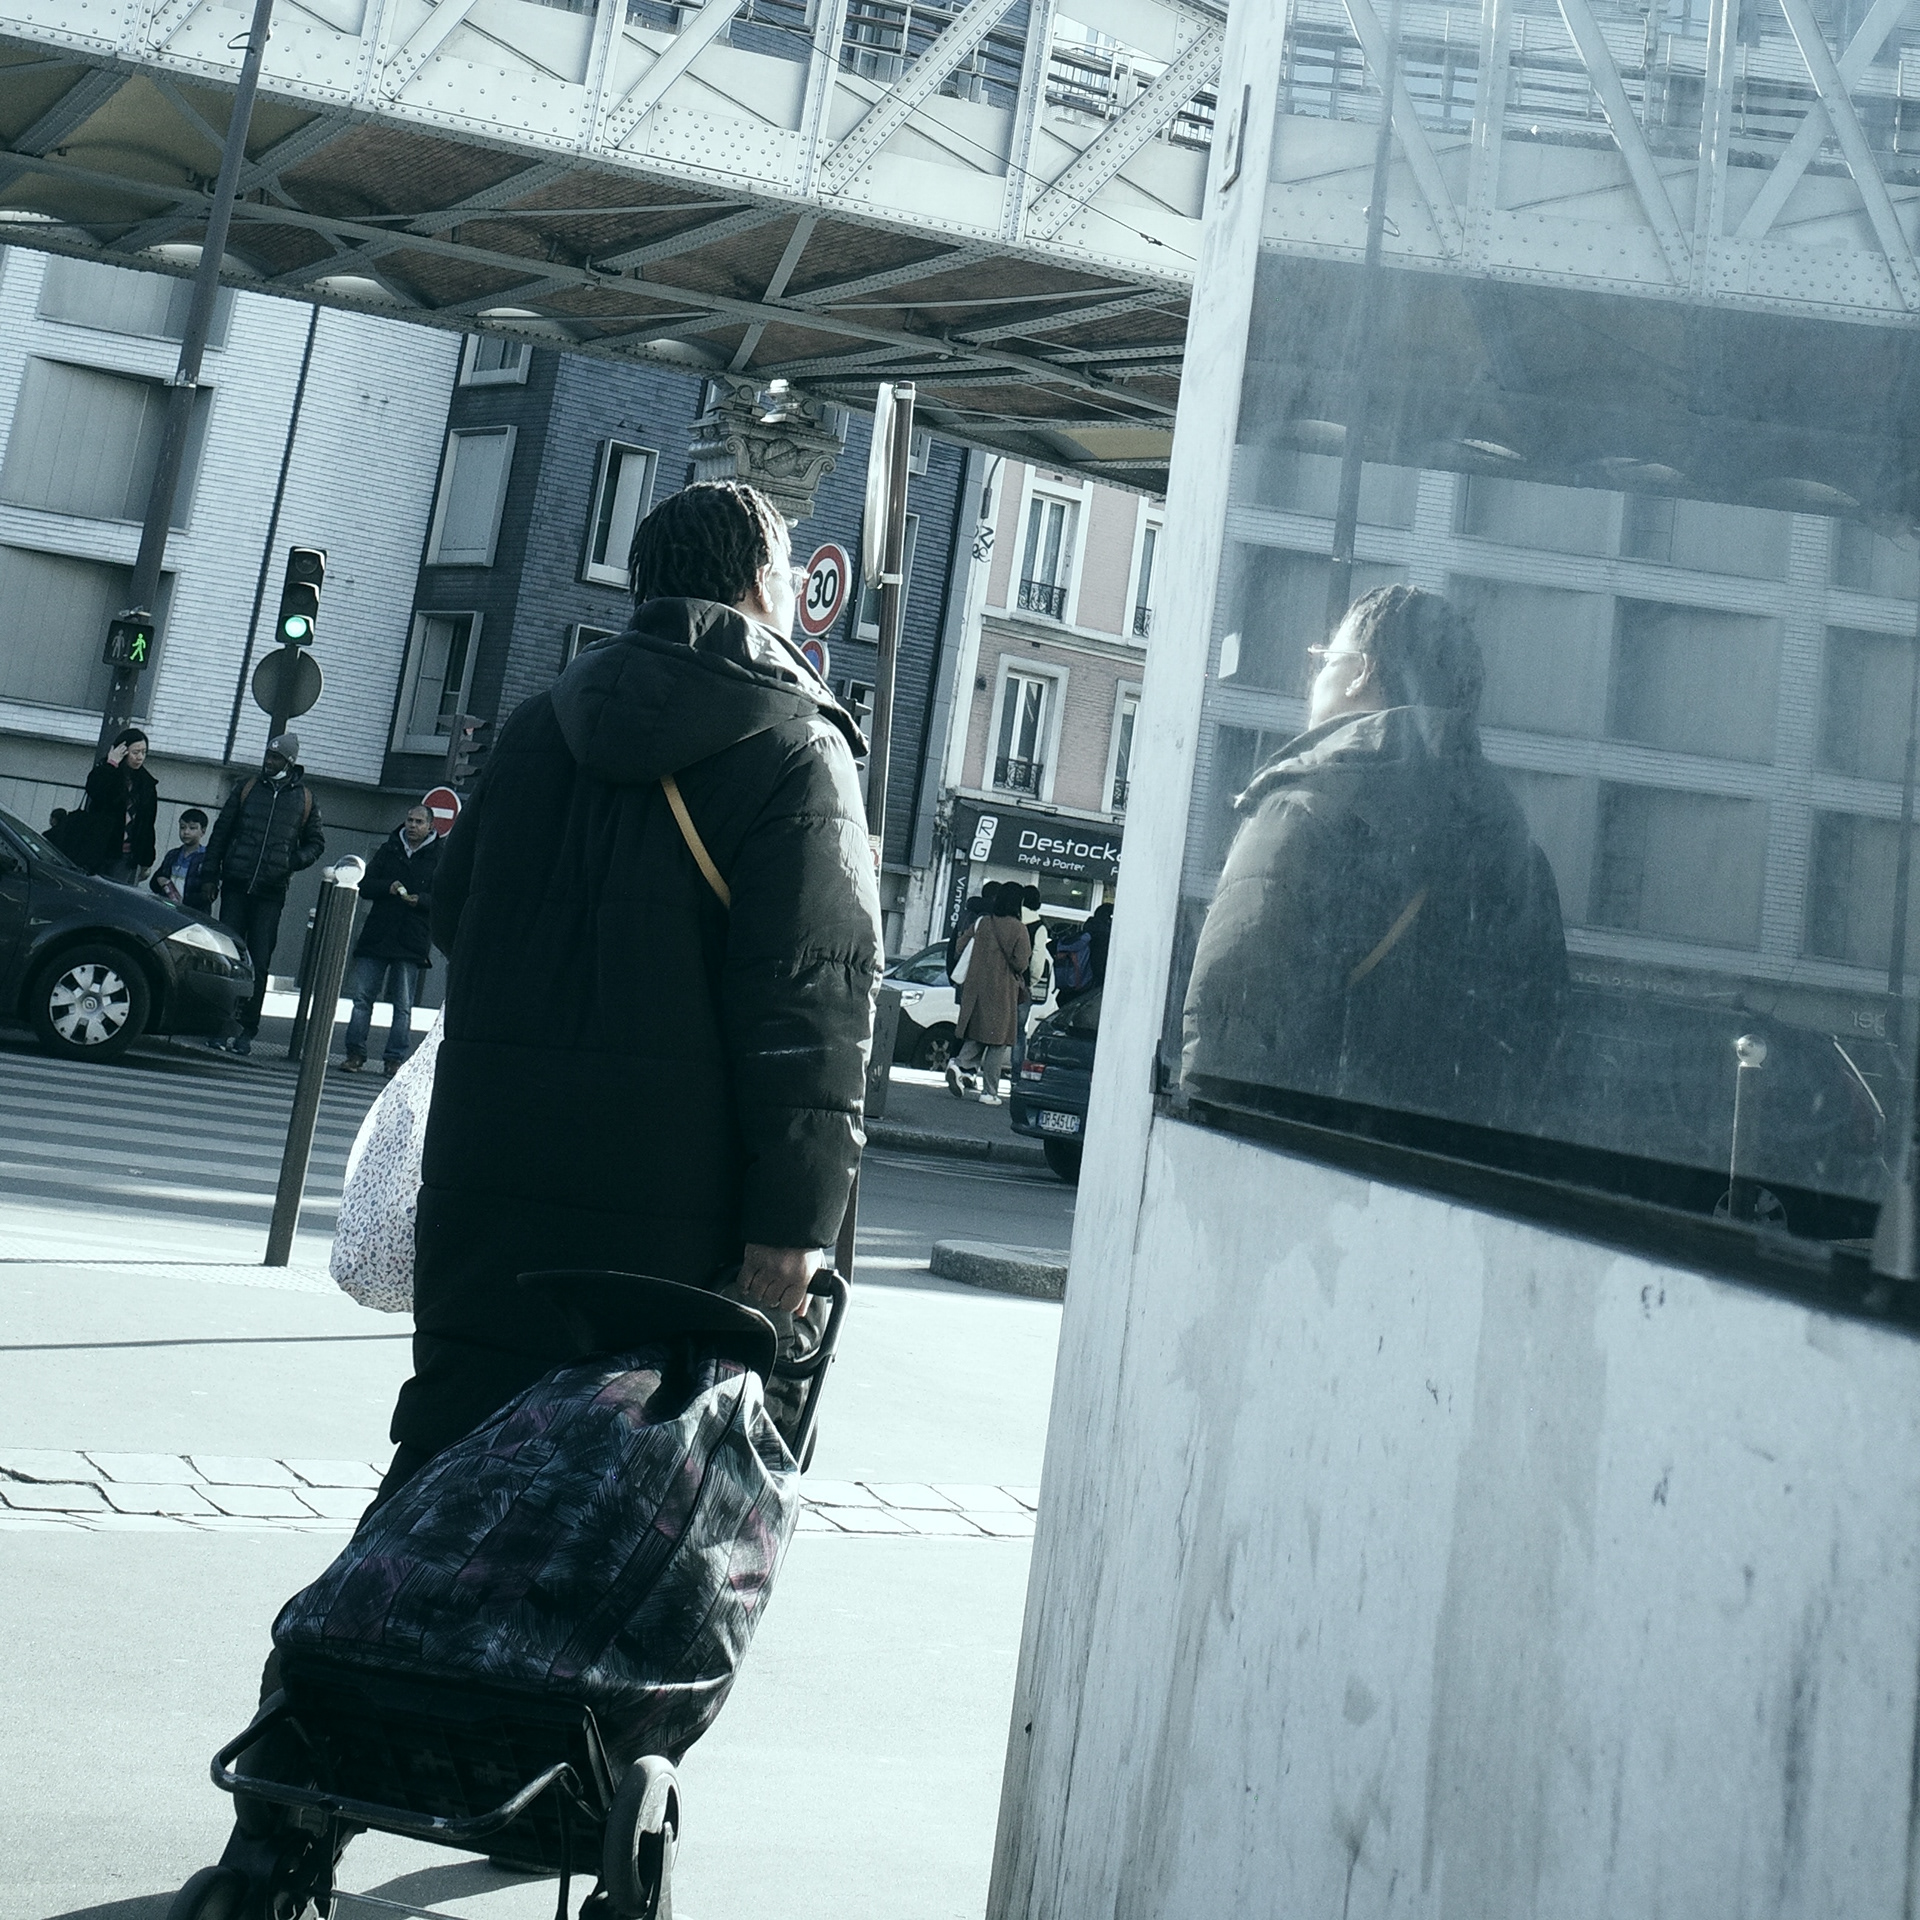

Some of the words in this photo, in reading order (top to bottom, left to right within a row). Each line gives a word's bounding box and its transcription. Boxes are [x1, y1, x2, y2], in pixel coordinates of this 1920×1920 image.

[808, 569, 838, 610] 30
[1017, 853, 1041, 866] Prêt
[1052, 858, 1086, 872] Porter
